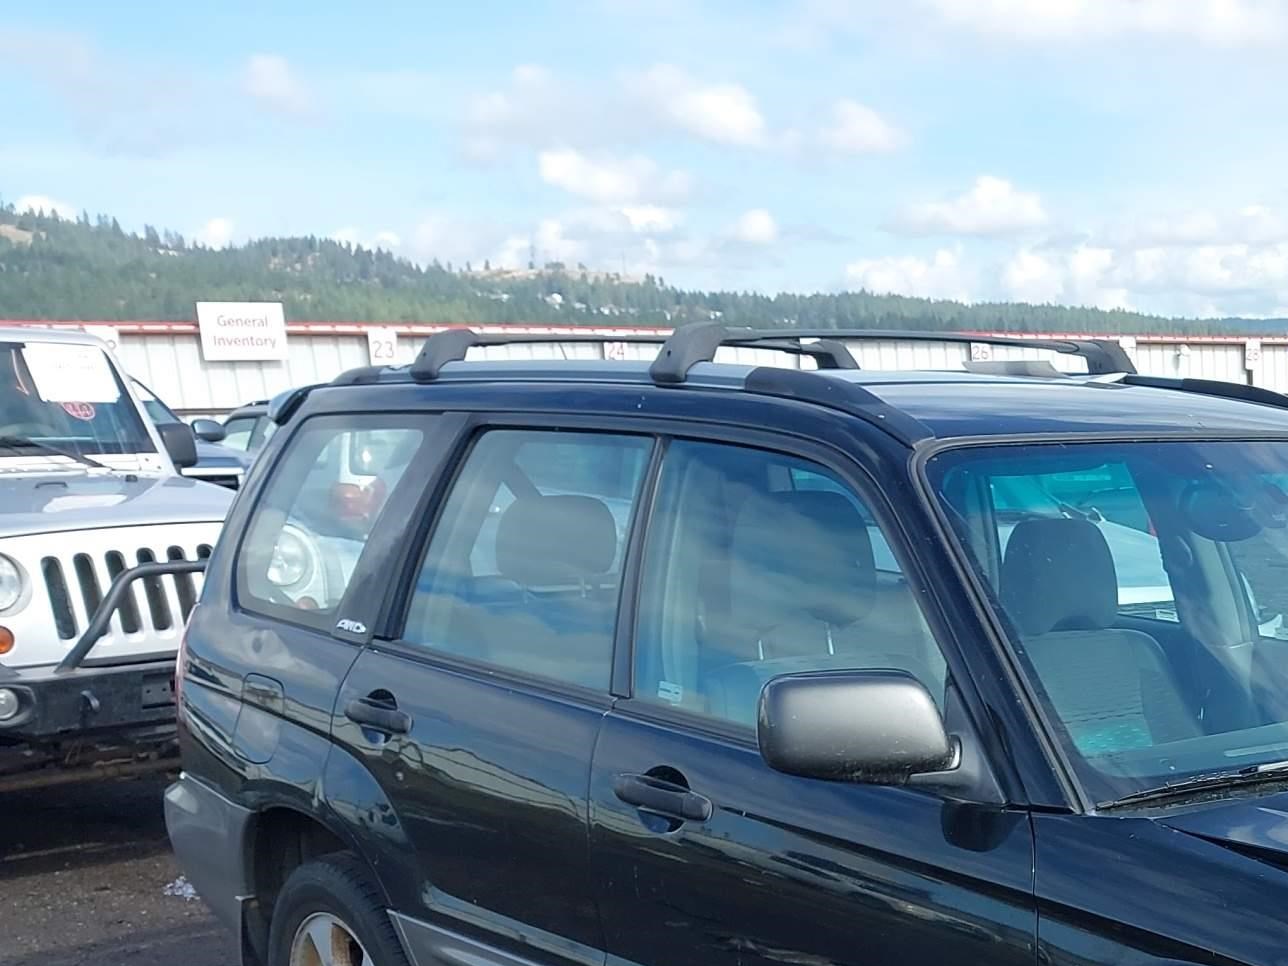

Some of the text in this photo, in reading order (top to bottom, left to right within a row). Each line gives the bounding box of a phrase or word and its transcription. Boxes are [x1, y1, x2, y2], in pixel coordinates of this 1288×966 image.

[216, 314, 268, 328] General
[213, 335, 277, 349] Inventory
[372, 340, 395, 359] 23
[972, 345, 990, 360] 26
